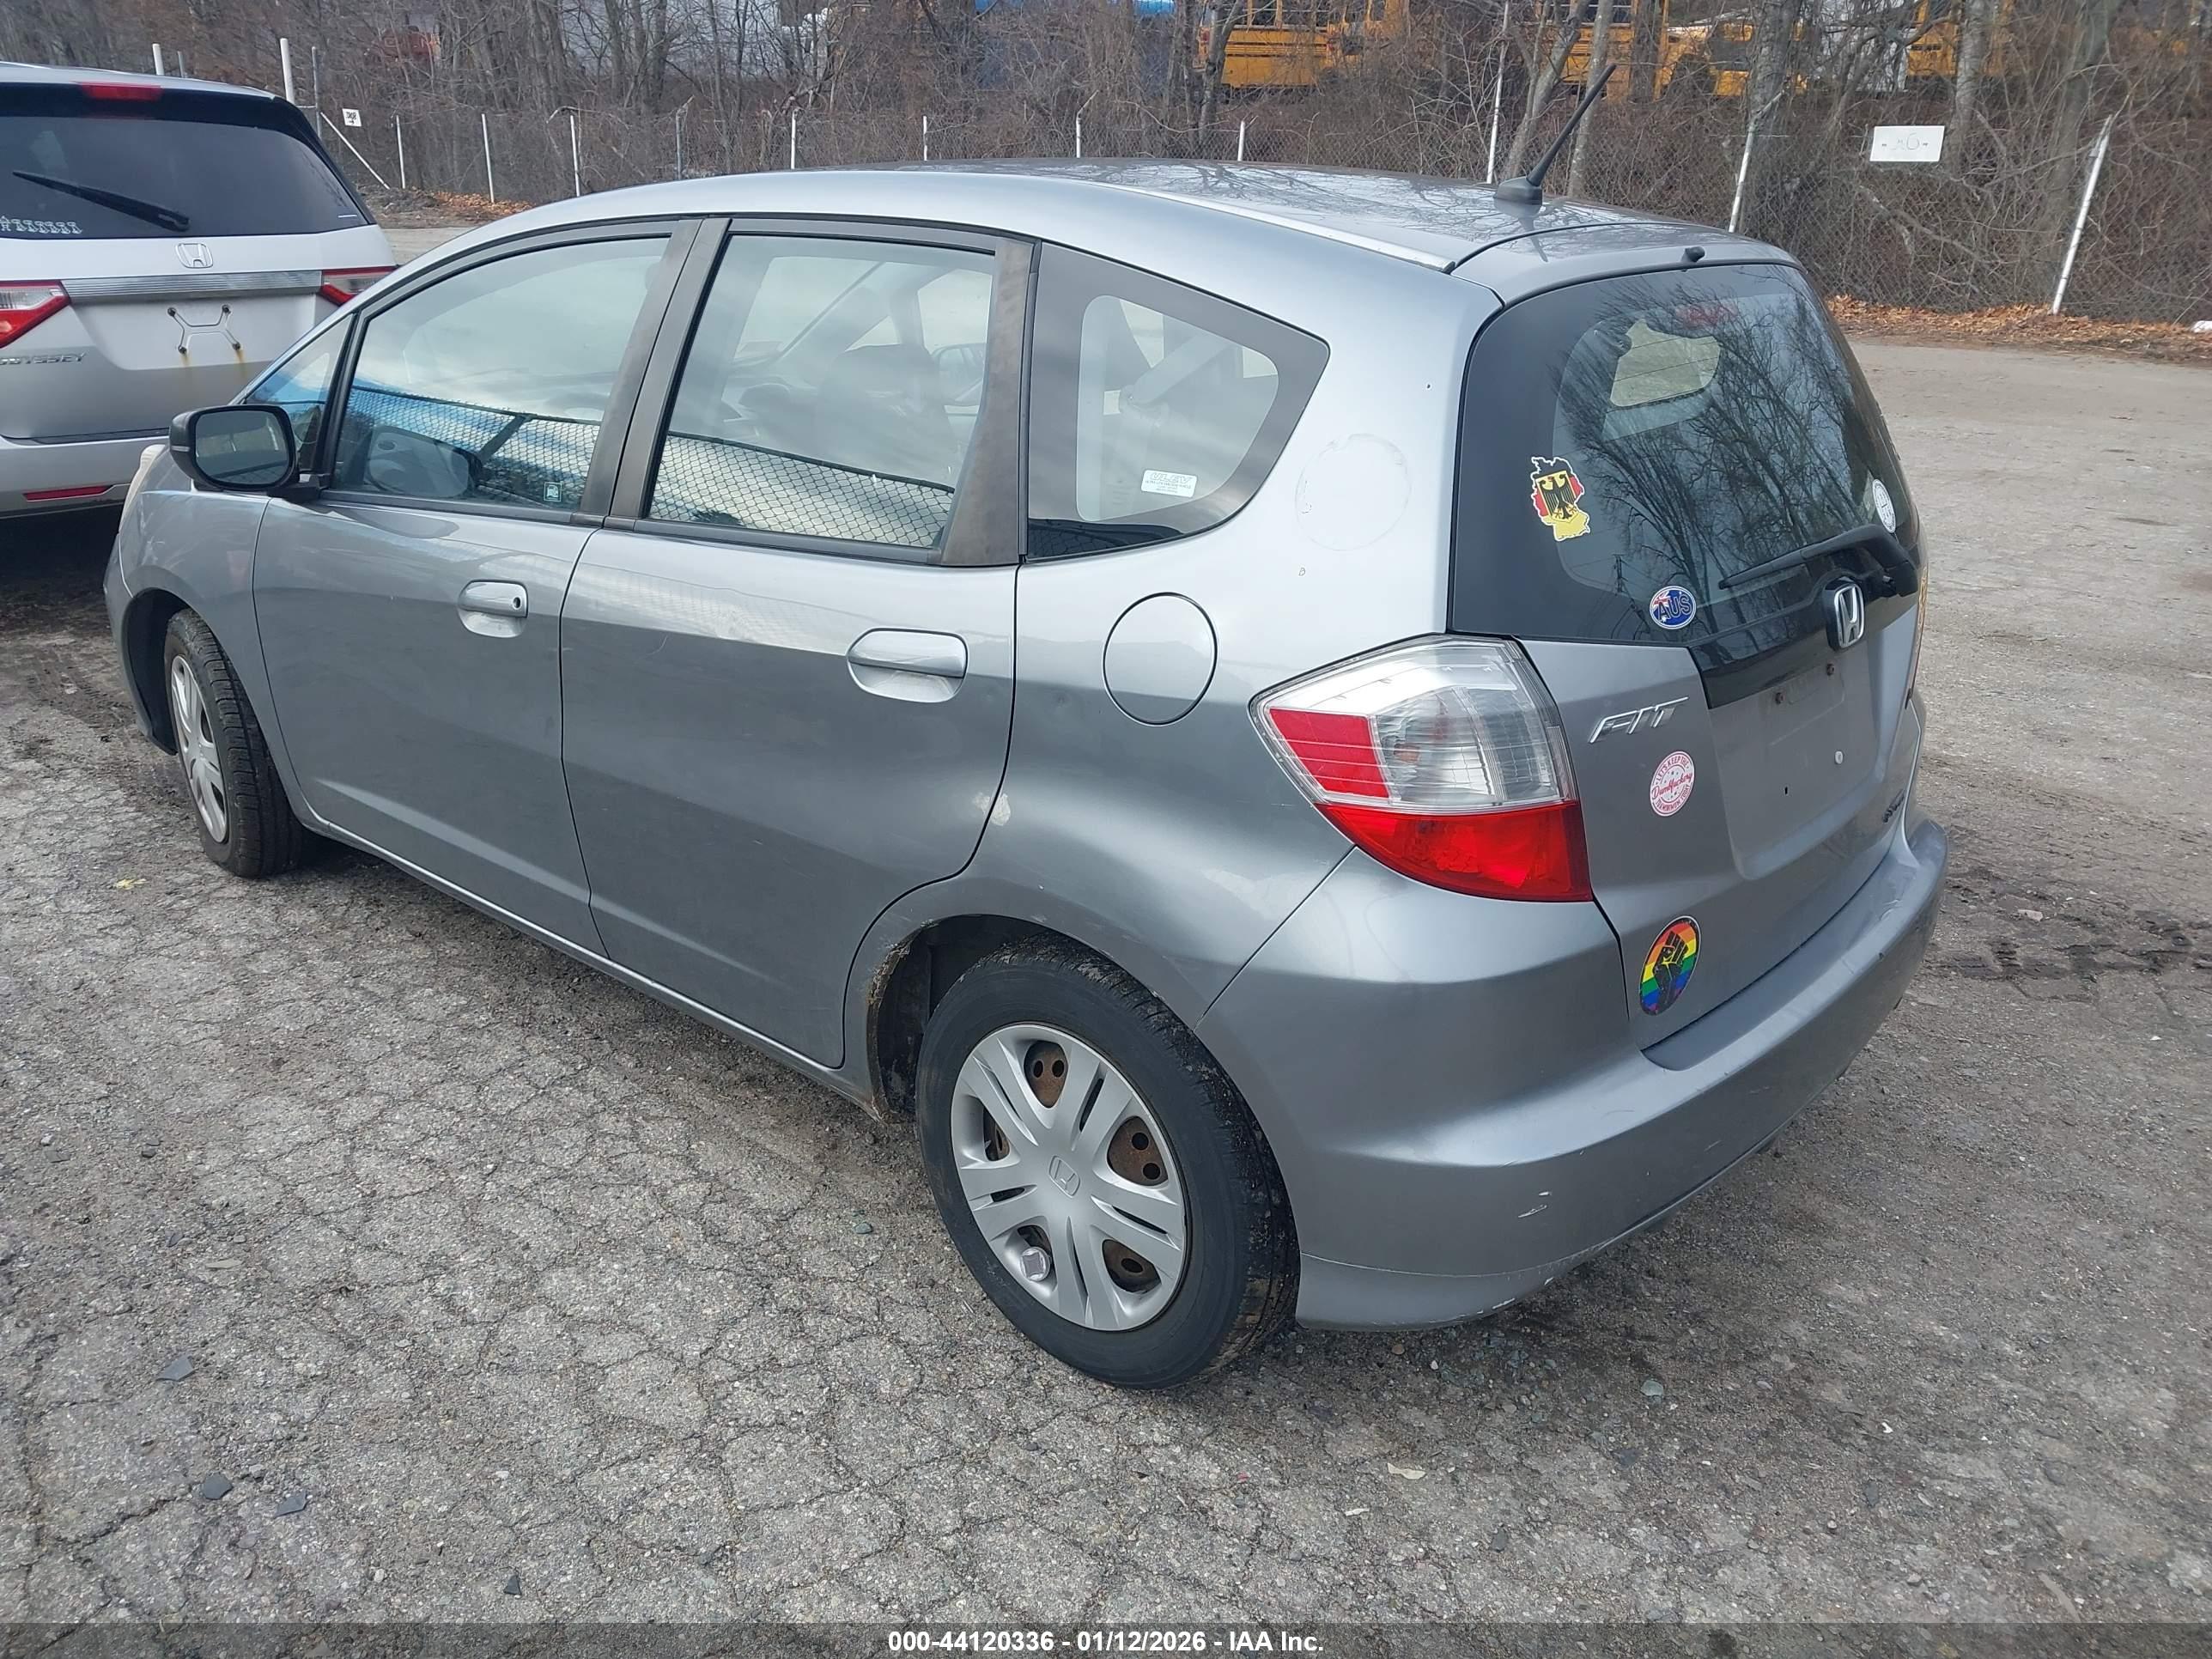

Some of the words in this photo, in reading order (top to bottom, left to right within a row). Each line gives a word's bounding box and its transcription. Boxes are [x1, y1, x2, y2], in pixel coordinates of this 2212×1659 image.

[1657, 593, 1692, 622] AUS
[1588, 696, 1689, 744] FIT
[1668, 756, 1681, 767] KEEP
